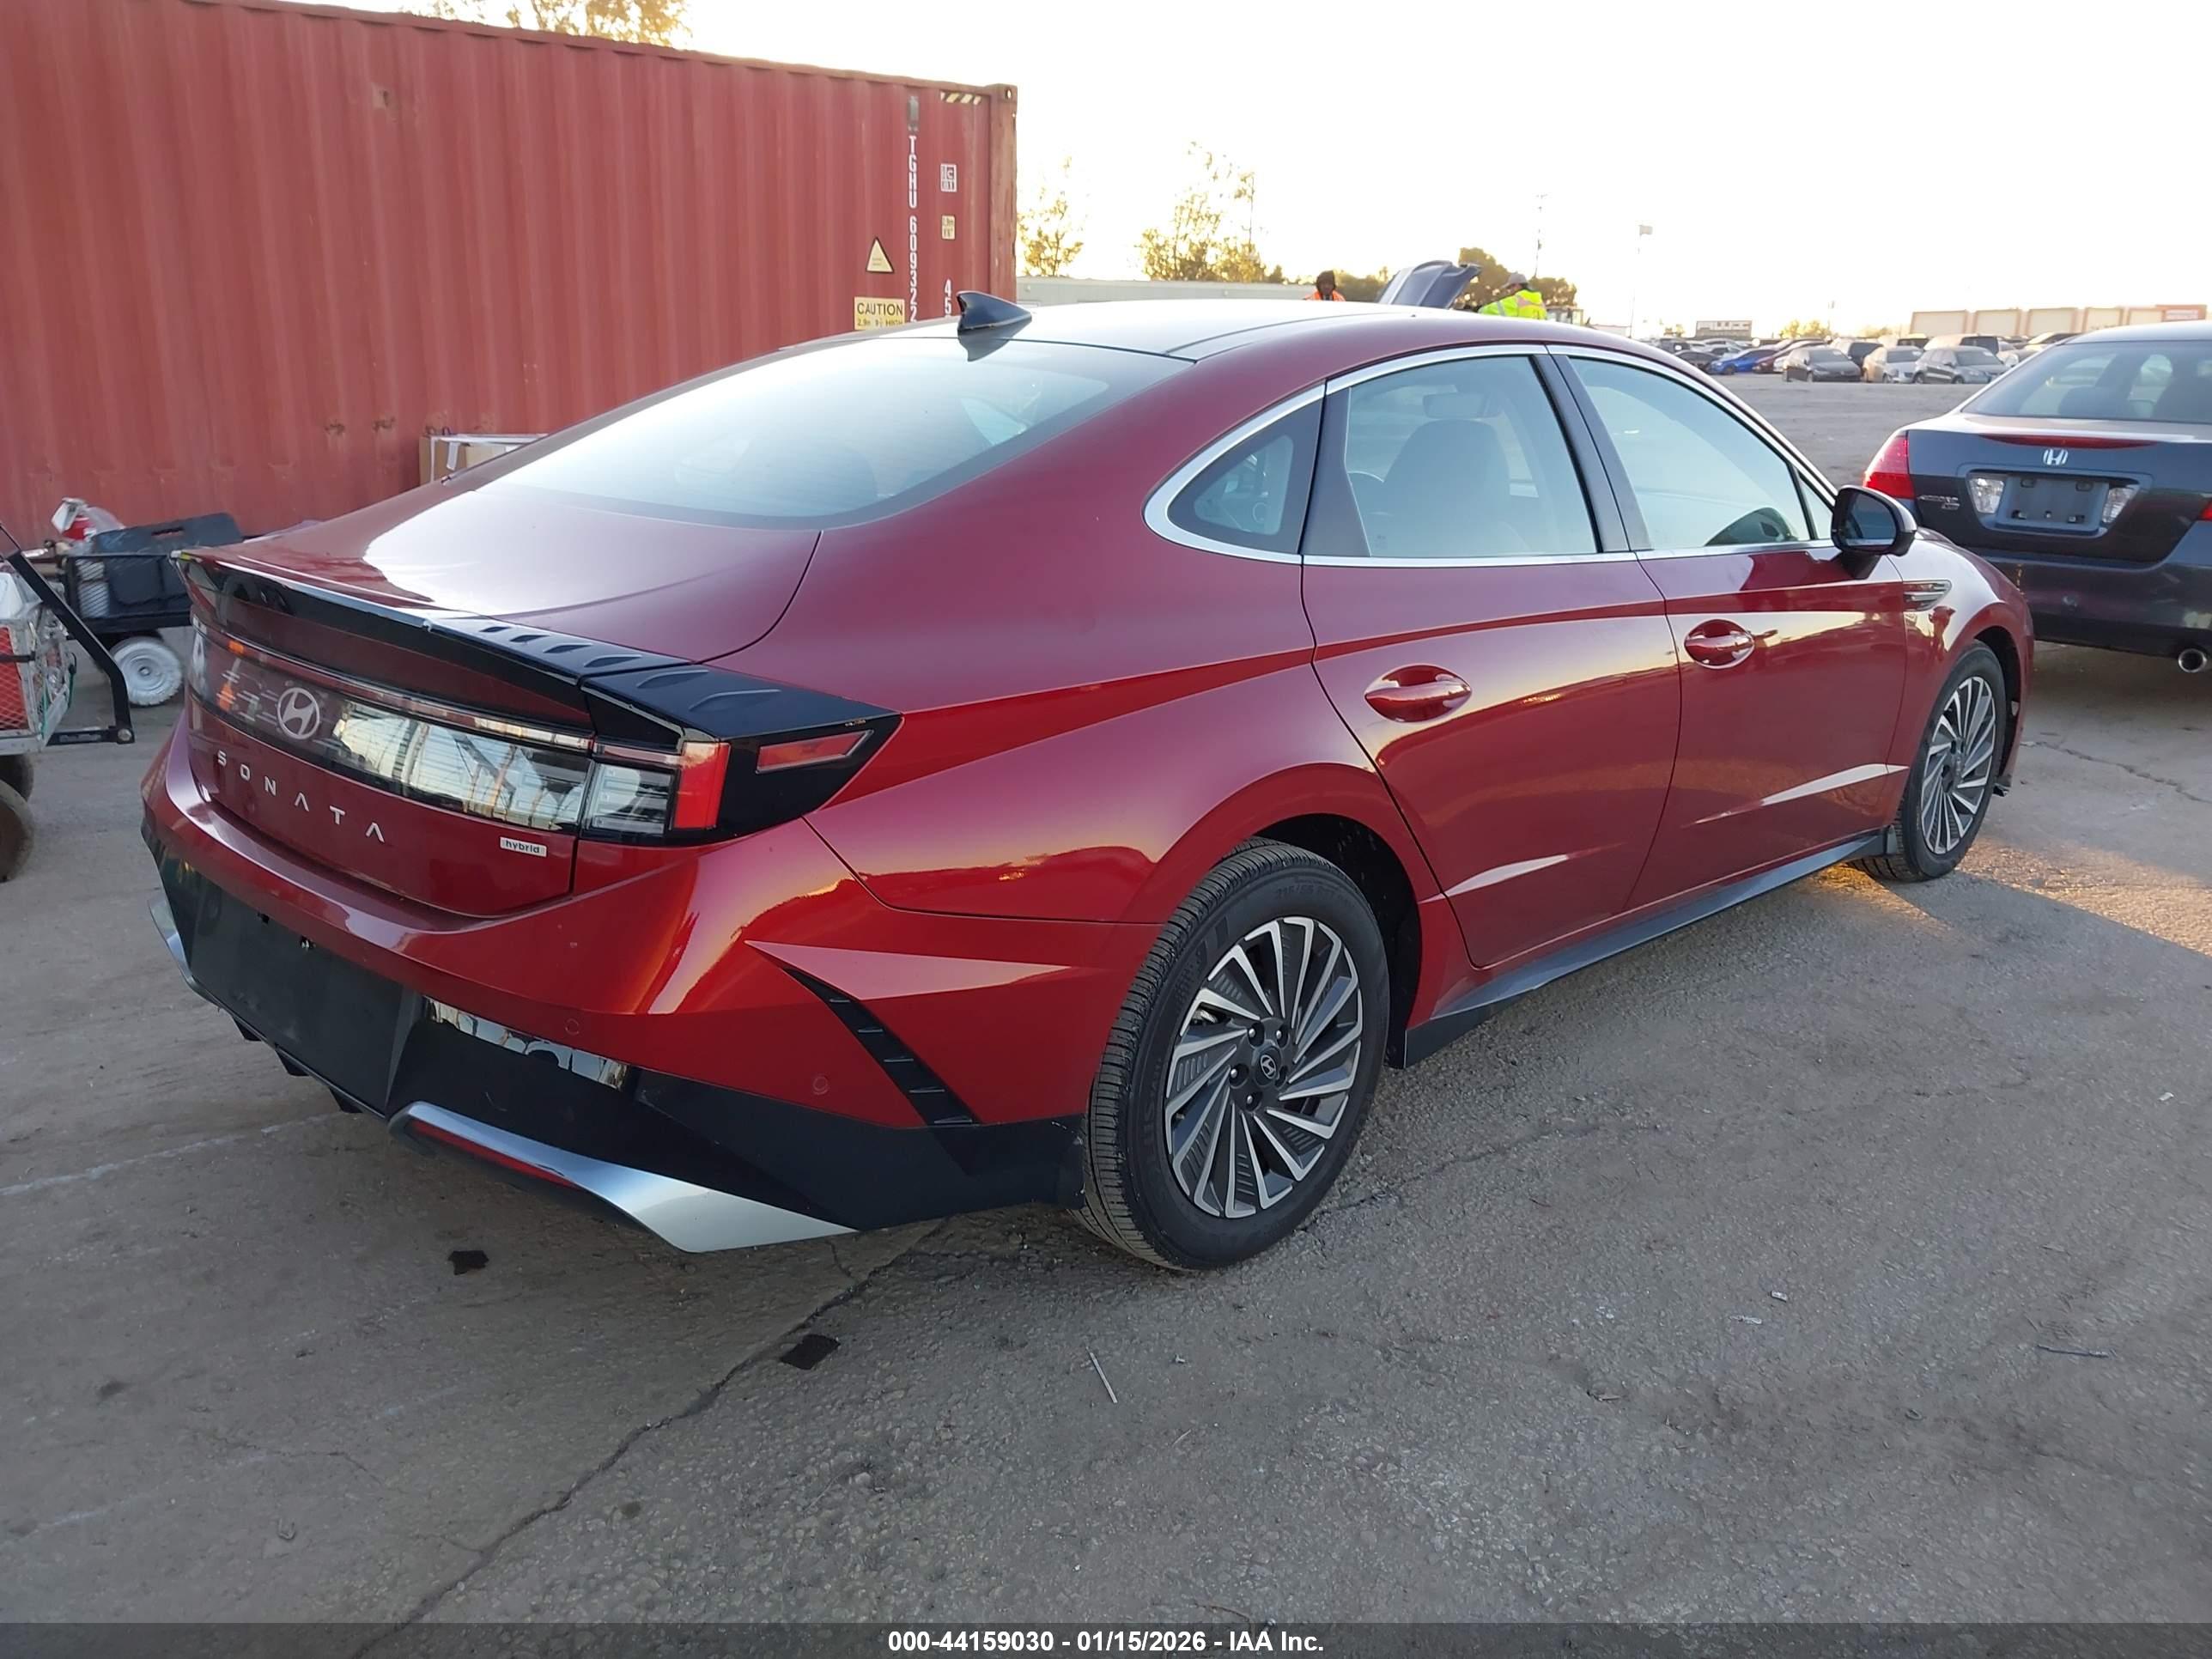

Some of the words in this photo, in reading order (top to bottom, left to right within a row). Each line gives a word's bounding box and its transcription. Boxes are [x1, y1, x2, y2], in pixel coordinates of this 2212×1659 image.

[908, 136, 918, 208] TGHU
[857, 302, 903, 316] CAUTION
[216, 750, 386, 843] SONATA
[504, 839, 541, 854] hybrid
